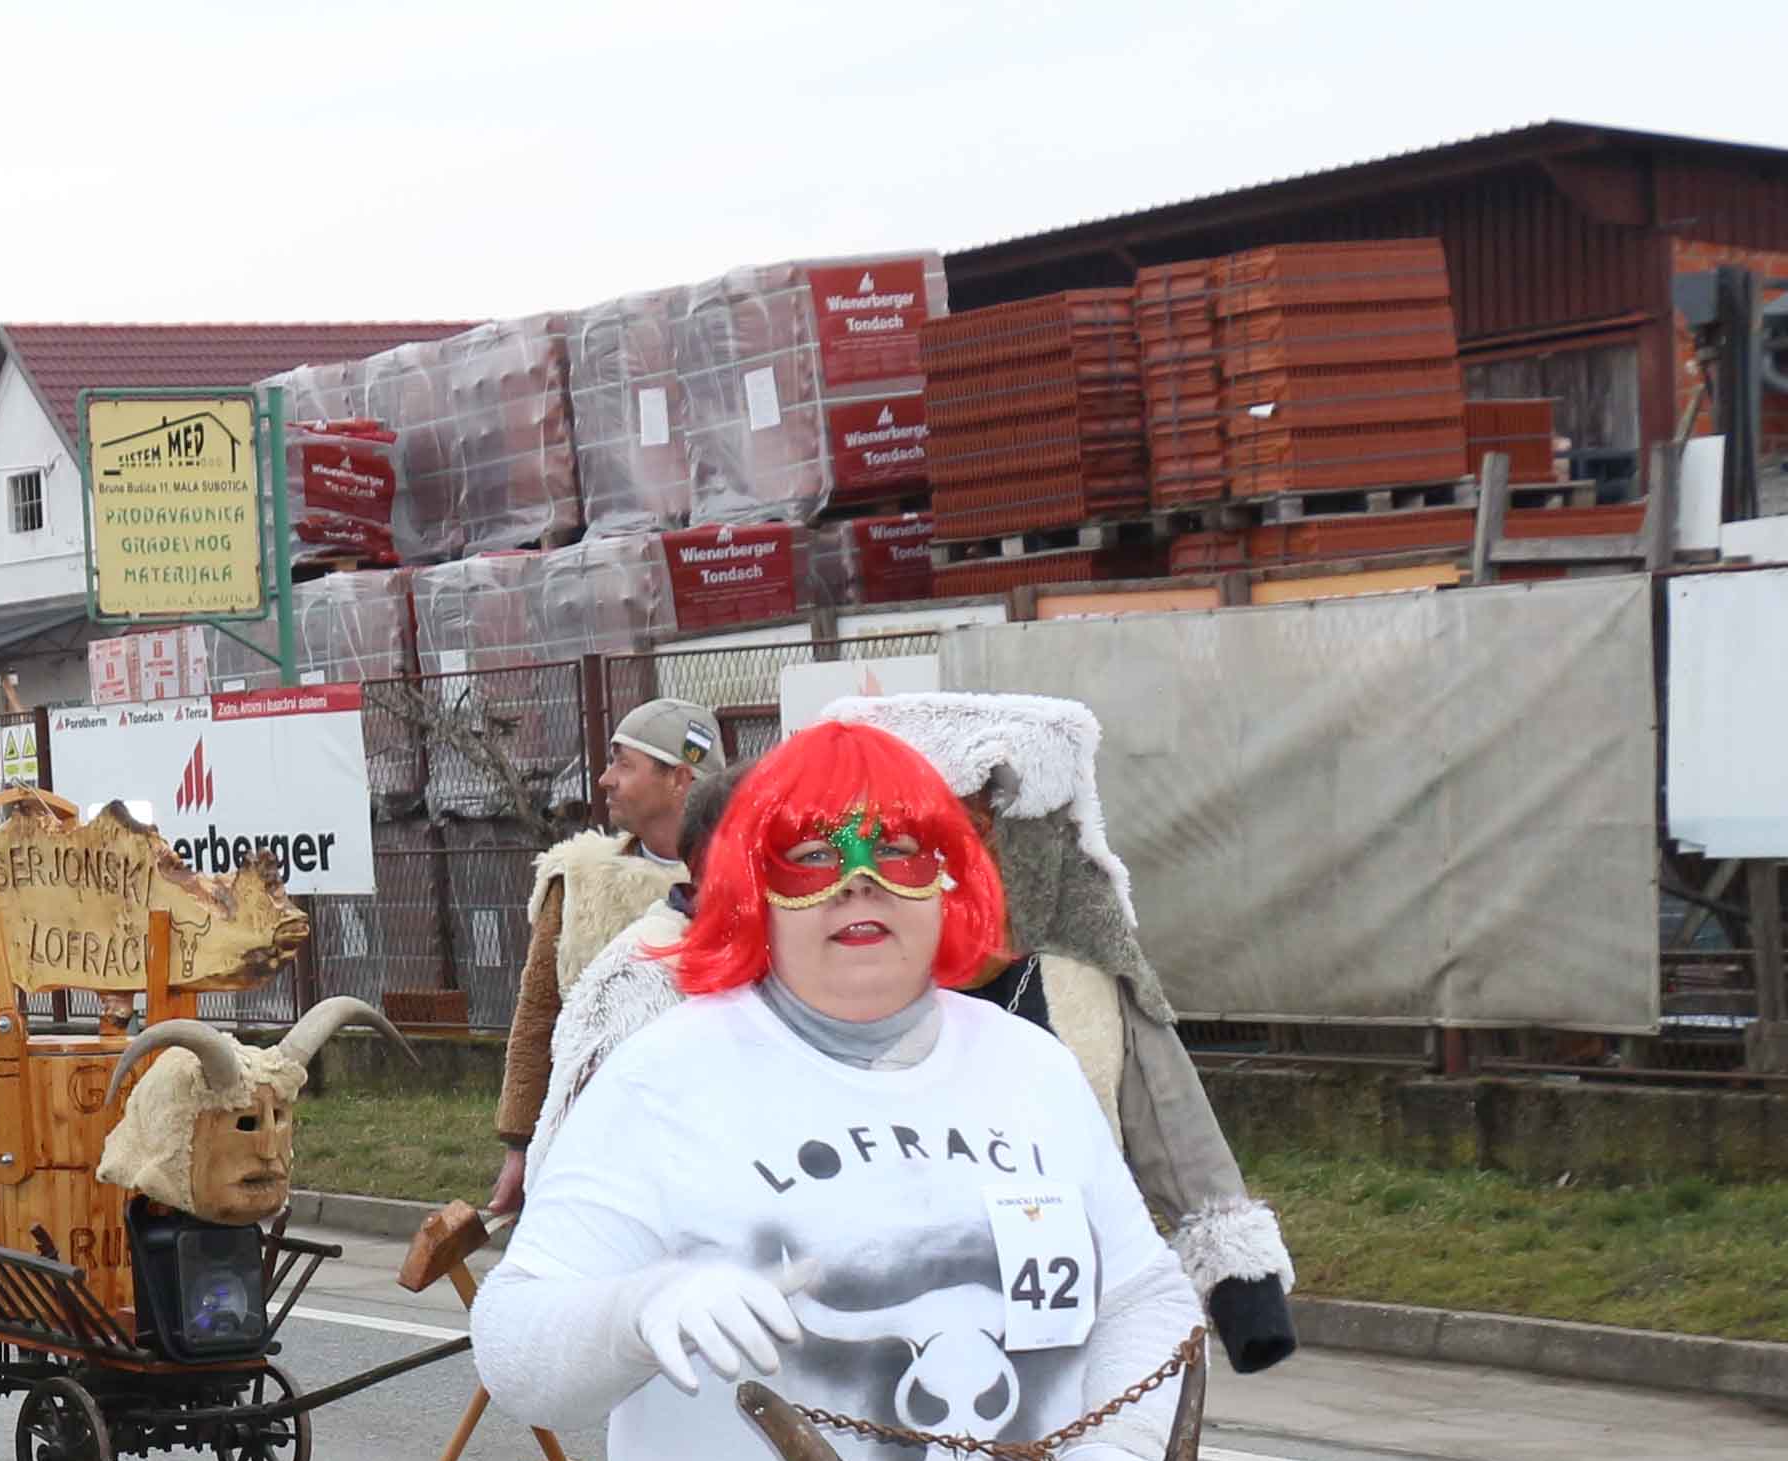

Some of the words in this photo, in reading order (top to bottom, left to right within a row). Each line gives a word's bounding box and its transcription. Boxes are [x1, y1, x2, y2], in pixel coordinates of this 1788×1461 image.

[826, 292, 915, 312] Wienerberger
[845, 314, 904, 332] Tondach
[863, 445, 925, 465] Tondach
[173, 481, 199, 492] MALA
[202, 480, 248, 492] SUBOTICA
[679, 541, 779, 563] Wienerberger
[124, 564, 233, 585] MATERIJALA
[700, 564, 763, 584] Tondach
[65, 716, 108, 730] Porotherm
[129, 708, 164, 724] Tondach
[173, 824, 335, 884] erberger
[753, 1125, 1045, 1194] LOFRAČI
[1011, 1256, 1080, 1311] 42
